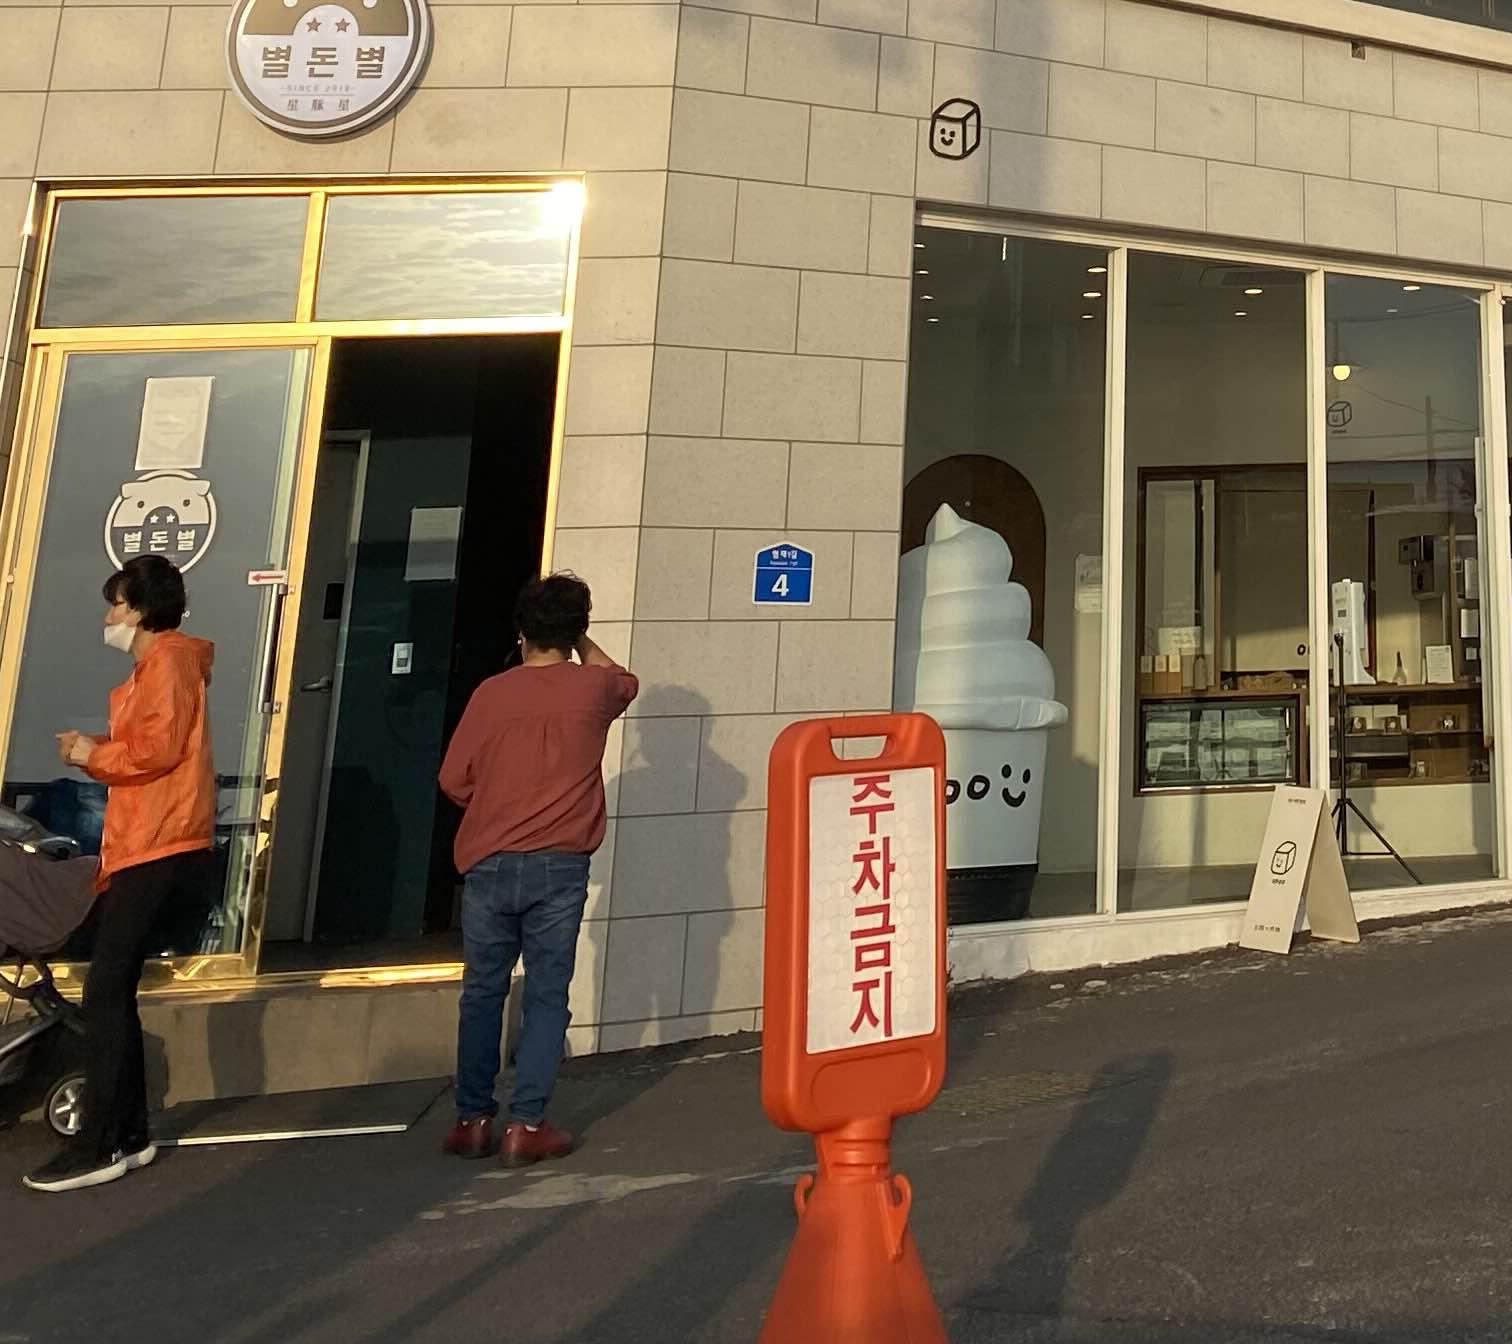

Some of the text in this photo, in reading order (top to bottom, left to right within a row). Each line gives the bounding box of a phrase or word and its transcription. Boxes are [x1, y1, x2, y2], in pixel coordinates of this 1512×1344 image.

[261, 45, 385, 79] 별돈별
[123, 529, 195, 553] 별돈별
[771, 573, 789, 597] 4
[849, 774, 896, 1038] 주차금지
